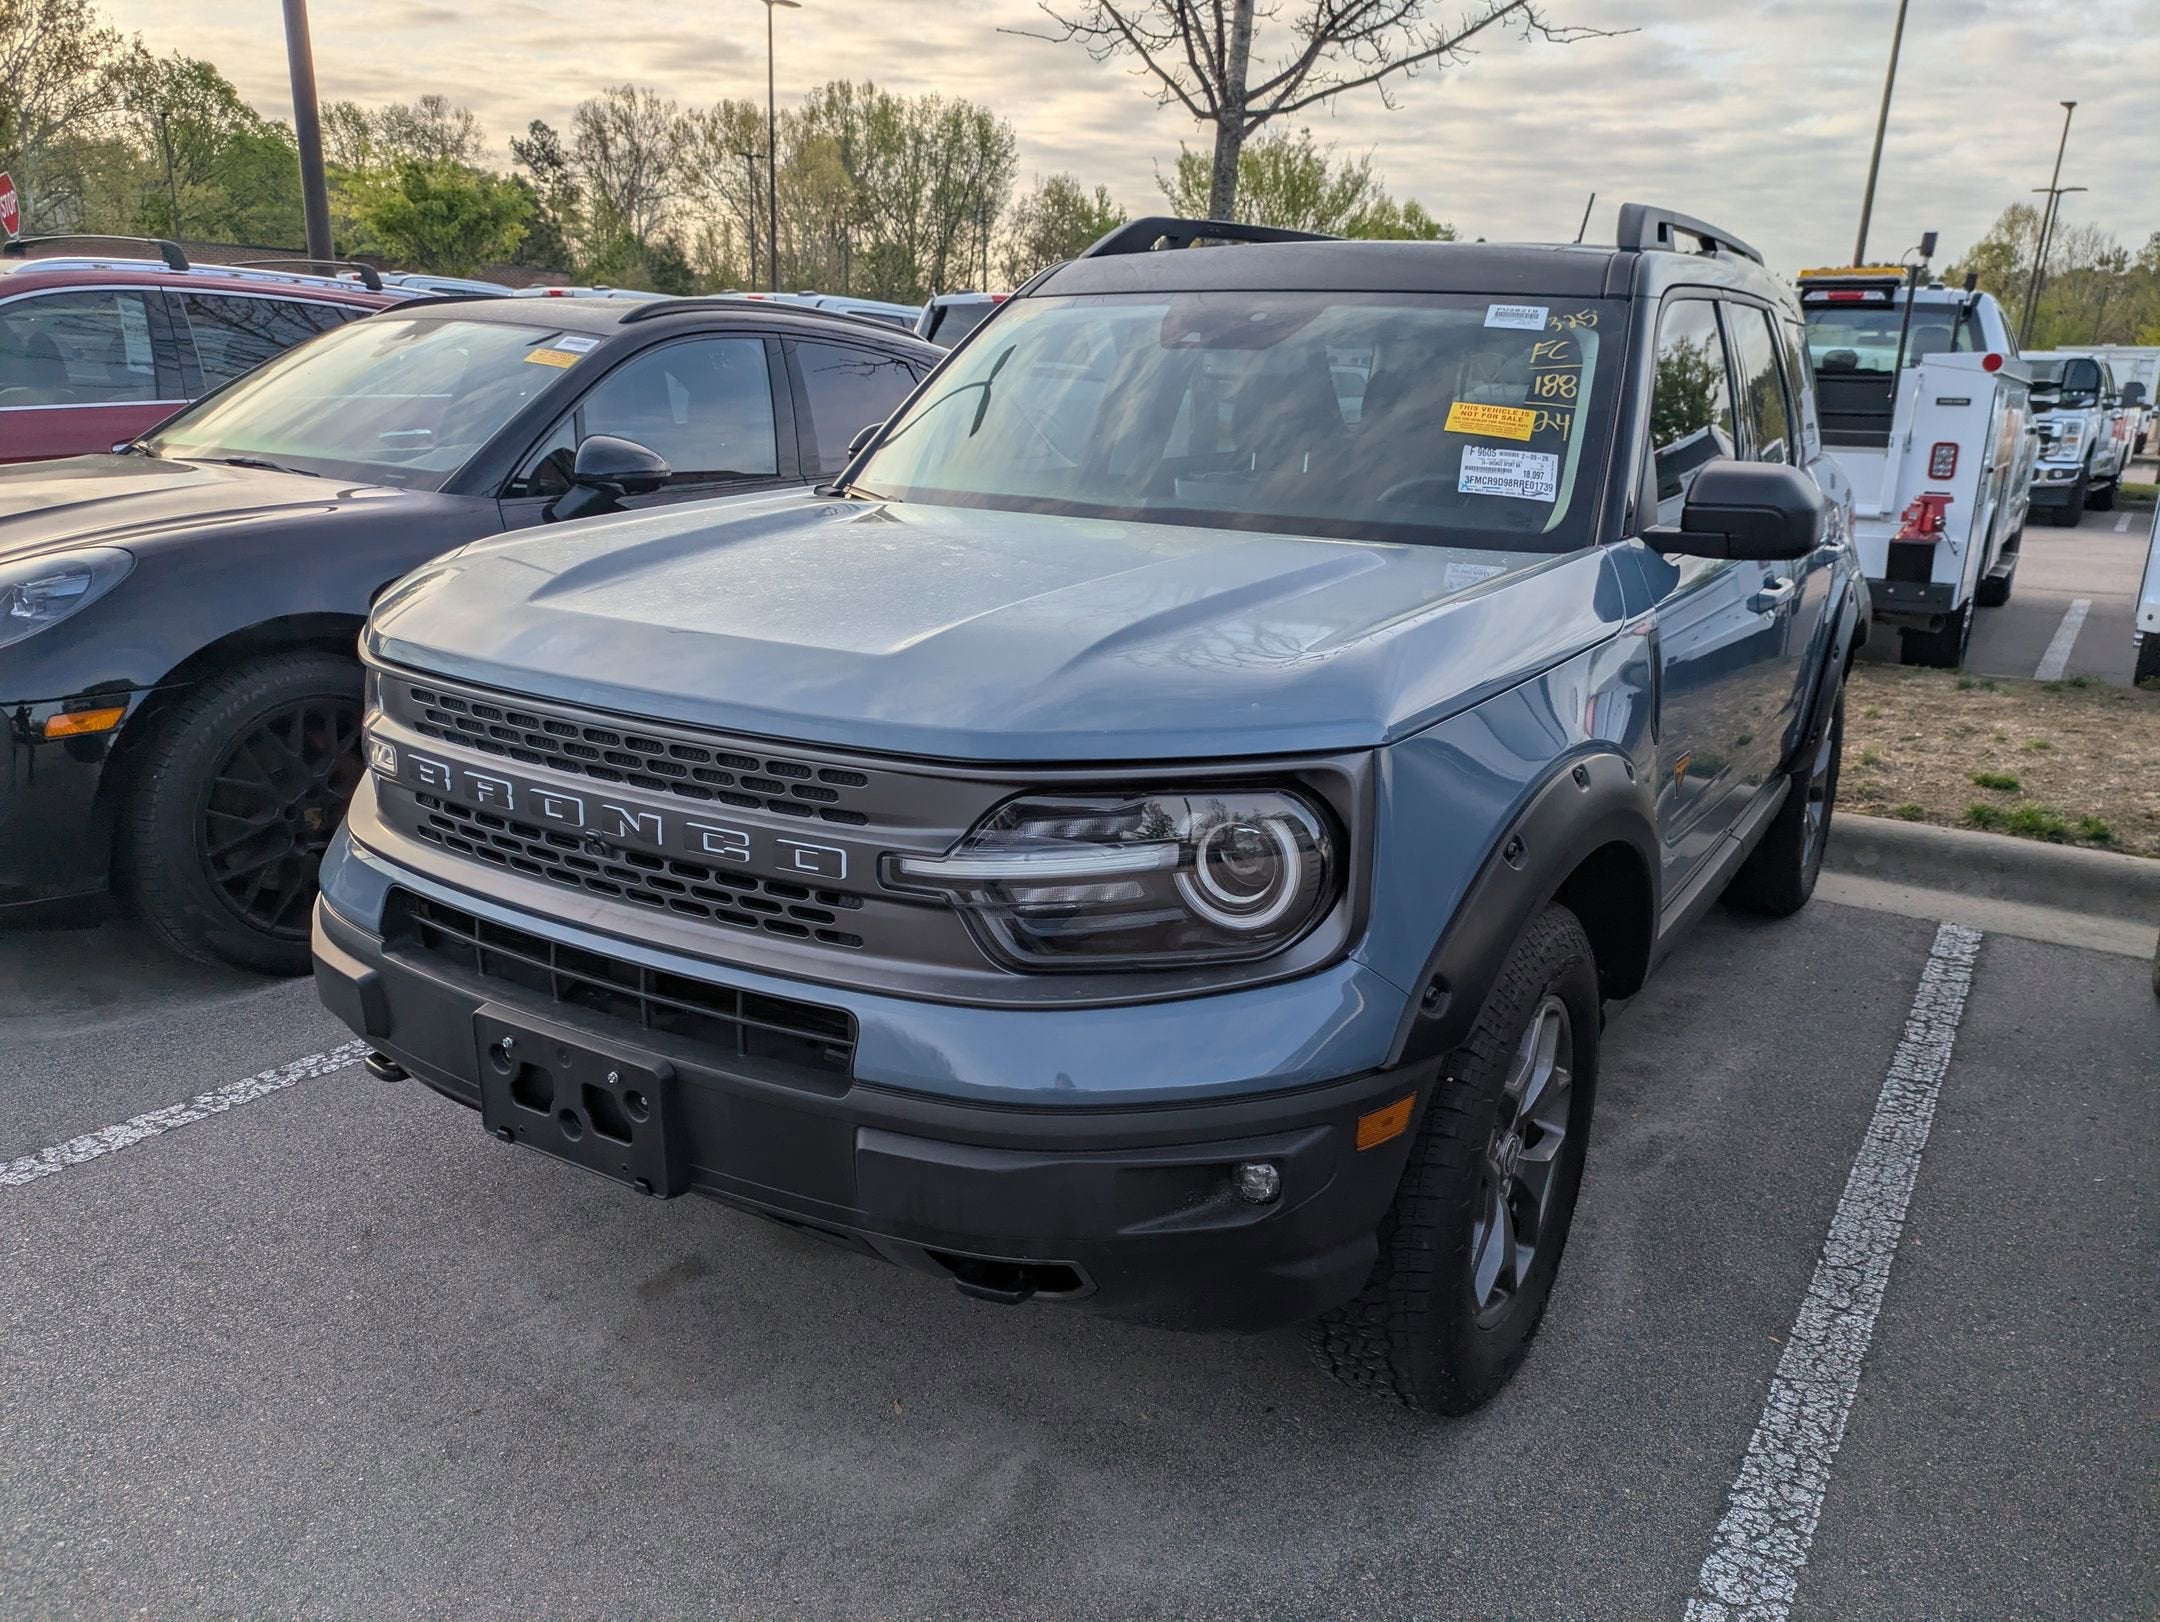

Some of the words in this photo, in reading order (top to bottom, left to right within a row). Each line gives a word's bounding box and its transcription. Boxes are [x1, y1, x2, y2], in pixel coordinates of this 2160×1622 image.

[0, 190, 16, 218] STOP
[1529, 340, 1570, 363] FC
[1534, 374, 1577, 398] 188
[1481, 406, 1518, 415] VEHICLE
[1534, 411, 1570, 441] 24
[1477, 447, 1497, 457] 9605
[407, 753, 848, 880] BRONCO
